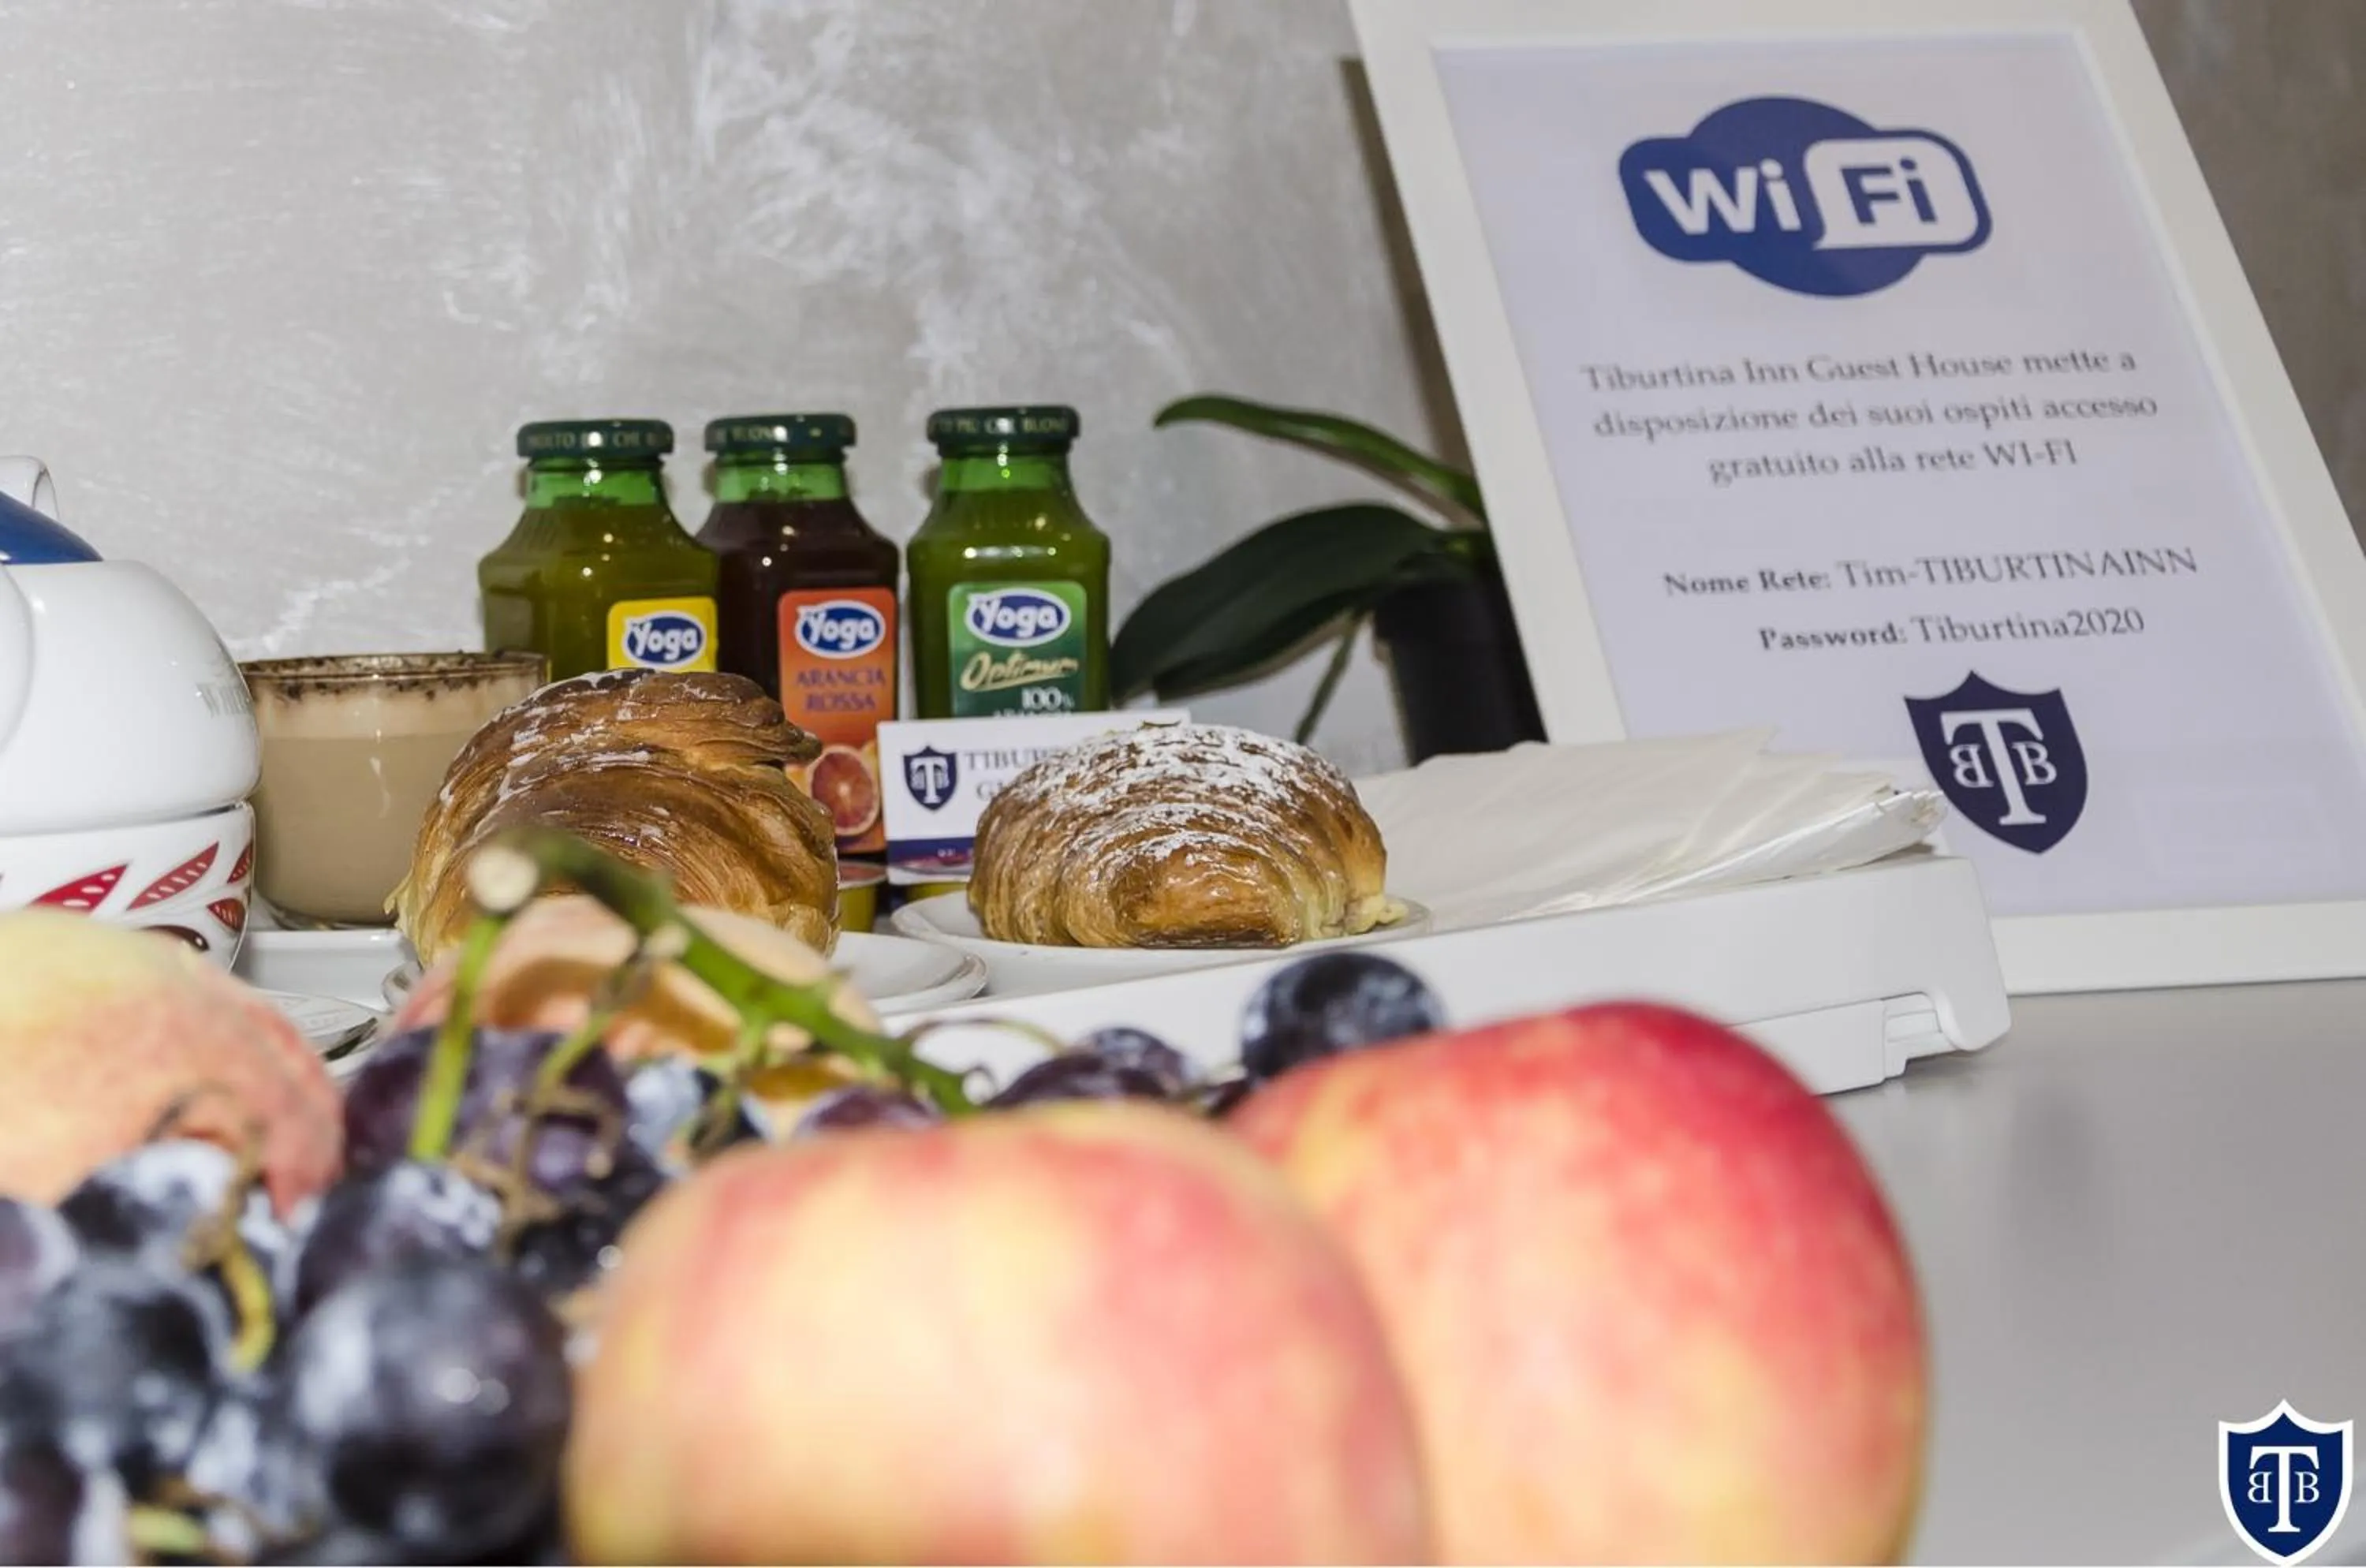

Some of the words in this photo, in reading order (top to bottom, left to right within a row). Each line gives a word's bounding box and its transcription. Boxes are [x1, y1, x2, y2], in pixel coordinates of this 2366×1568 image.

[1579, 363, 1734, 391] Tiburtina
[1742, 357, 1800, 384] Inn
[1807, 354, 1899, 381] Guest
[1908, 353, 2012, 378] House
[2024, 349, 2110, 374] mette
[2120, 352, 2136, 371] a
[1594, 405, 1797, 444] disposizione
[1808, 400, 1858, 428] dei
[1867, 400, 1934, 426] suoi
[1944, 396, 2032, 430] ospiti
[2044, 398, 2158, 420] accesso
[1708, 450, 1839, 488] gratuito
[1849, 446, 1905, 474] alla
[1915, 447, 1976, 471] rete
[1982, 439, 2077, 468] WI-FI
[1664, 573, 1750, 597] Nome
[1759, 567, 1831, 592] Rete:
[1834, 547, 2197, 588] Tim-TIBURTINAINN
[802, 608, 875, 650] Yoga
[972, 595, 1058, 637] Yoga
[1760, 622, 1908, 651] Password:
[1909, 607, 2144, 644] Tiburtina2020
[630, 621, 697, 661] Yoga
[797, 667, 886, 688] ARANCIA
[961, 650, 1079, 693] Optimum
[807, 693, 876, 711] ROSSA
